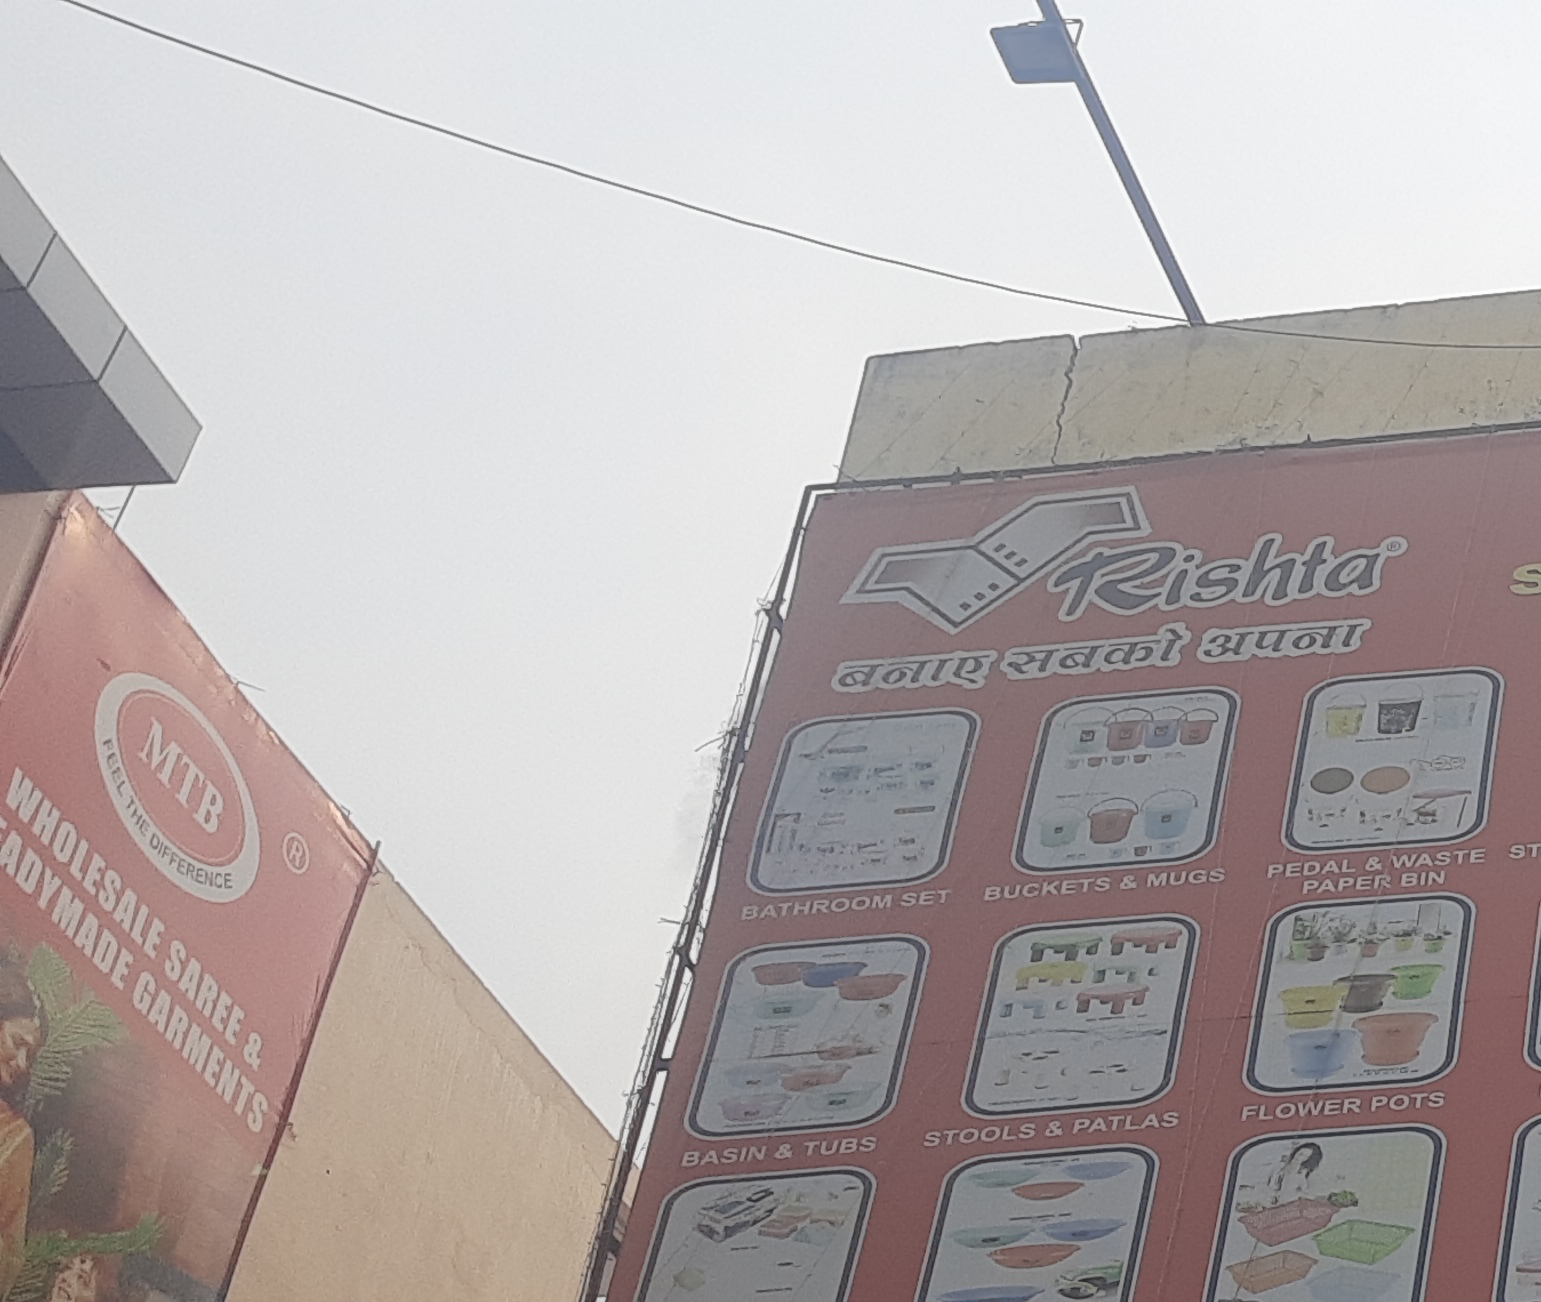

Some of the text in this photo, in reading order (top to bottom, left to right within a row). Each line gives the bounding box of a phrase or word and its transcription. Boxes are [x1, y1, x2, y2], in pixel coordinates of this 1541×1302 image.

[1046, 531, 1388, 622] Rishta
[831, 618, 1372, 692] बनाए सबको अपना
[137, 716, 225, 835] MTB
[103, 738, 233, 889] FEEL THE DIFFERENCE
[1267, 849, 1486, 878] PEDAL & WASTE
[1302, 870, 1446, 894] PAPER BIN
[983, 867, 1226, 901] BUCKETS & MUGS
[6, 767, 264, 1072] WHOLESALE SAREE &
[741, 889, 952, 920] BATHROOM SET
[0, 812, 269, 1133] ADYMADE GARMENTS
[1241, 1091, 1446, 1122] FLOWER POTS
[923, 1111, 1180, 1148] STOOLS & PATLAS
[680, 1136, 878, 1168] BASIN & TUBS
